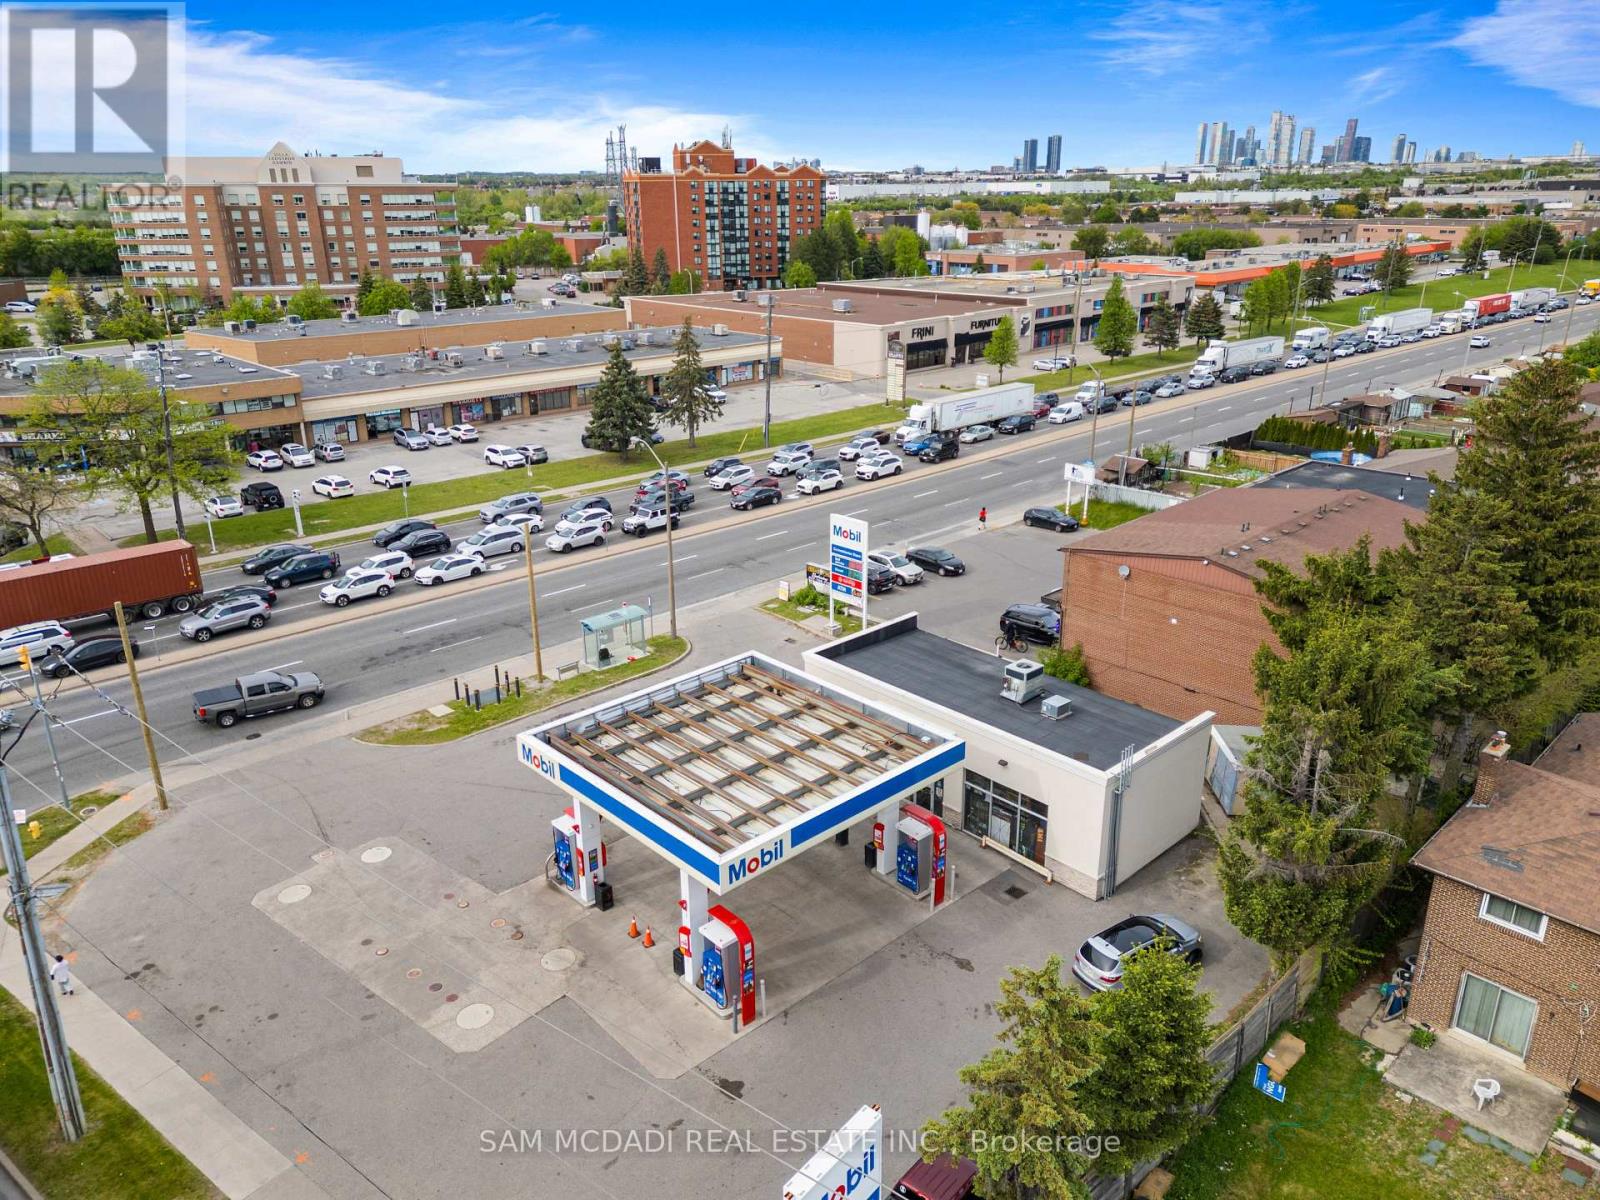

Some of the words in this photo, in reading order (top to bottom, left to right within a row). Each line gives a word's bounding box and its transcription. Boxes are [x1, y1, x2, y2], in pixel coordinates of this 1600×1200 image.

[911, 326, 935, 340] FRINI
[970, 316, 1002, 331] FURNITU
[833, 525, 861, 542] Mobil
[522, 743, 555, 779] Mobil
[728, 839, 784, 884] Mobil
[821, 1144, 875, 1200] obil
